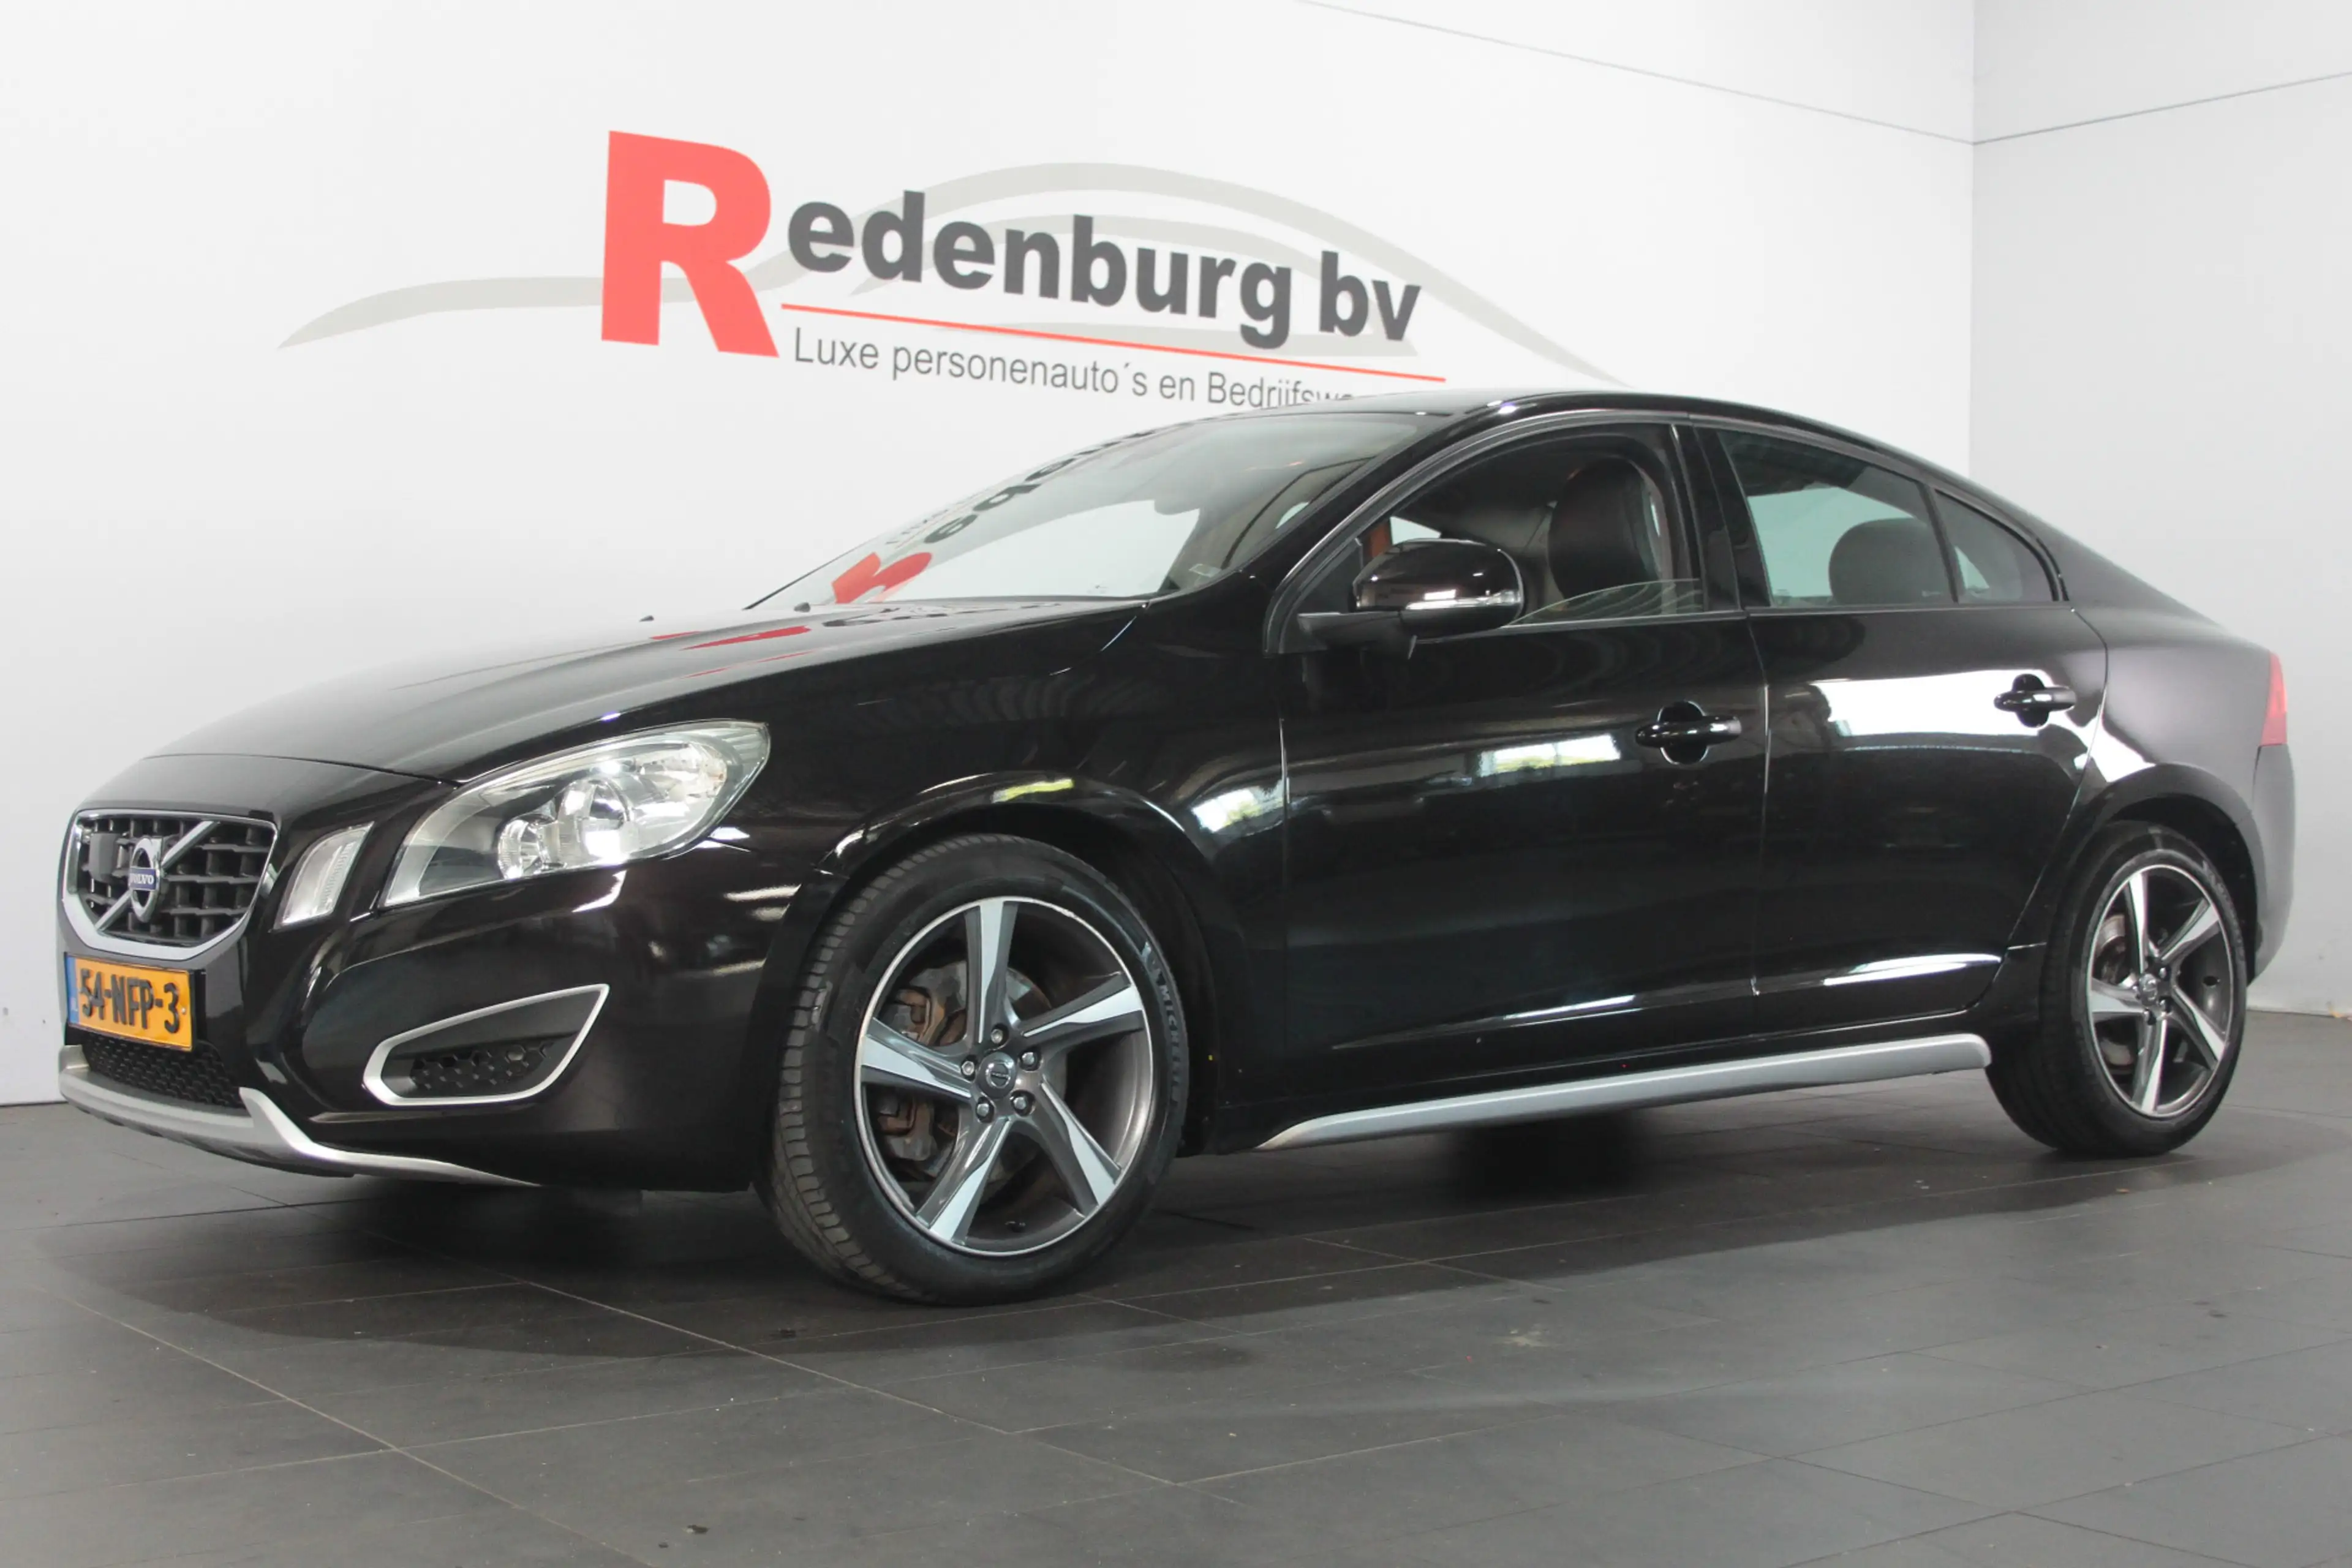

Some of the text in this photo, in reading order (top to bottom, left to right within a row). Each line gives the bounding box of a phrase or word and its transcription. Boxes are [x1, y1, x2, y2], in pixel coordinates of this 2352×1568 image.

[601, 130, 1421, 358] Redenburg bv
[796, 327, 879, 369] Luxe
[1159, 375, 1194, 401] en
[80, 968, 180, 1034] 54-NFP-3
